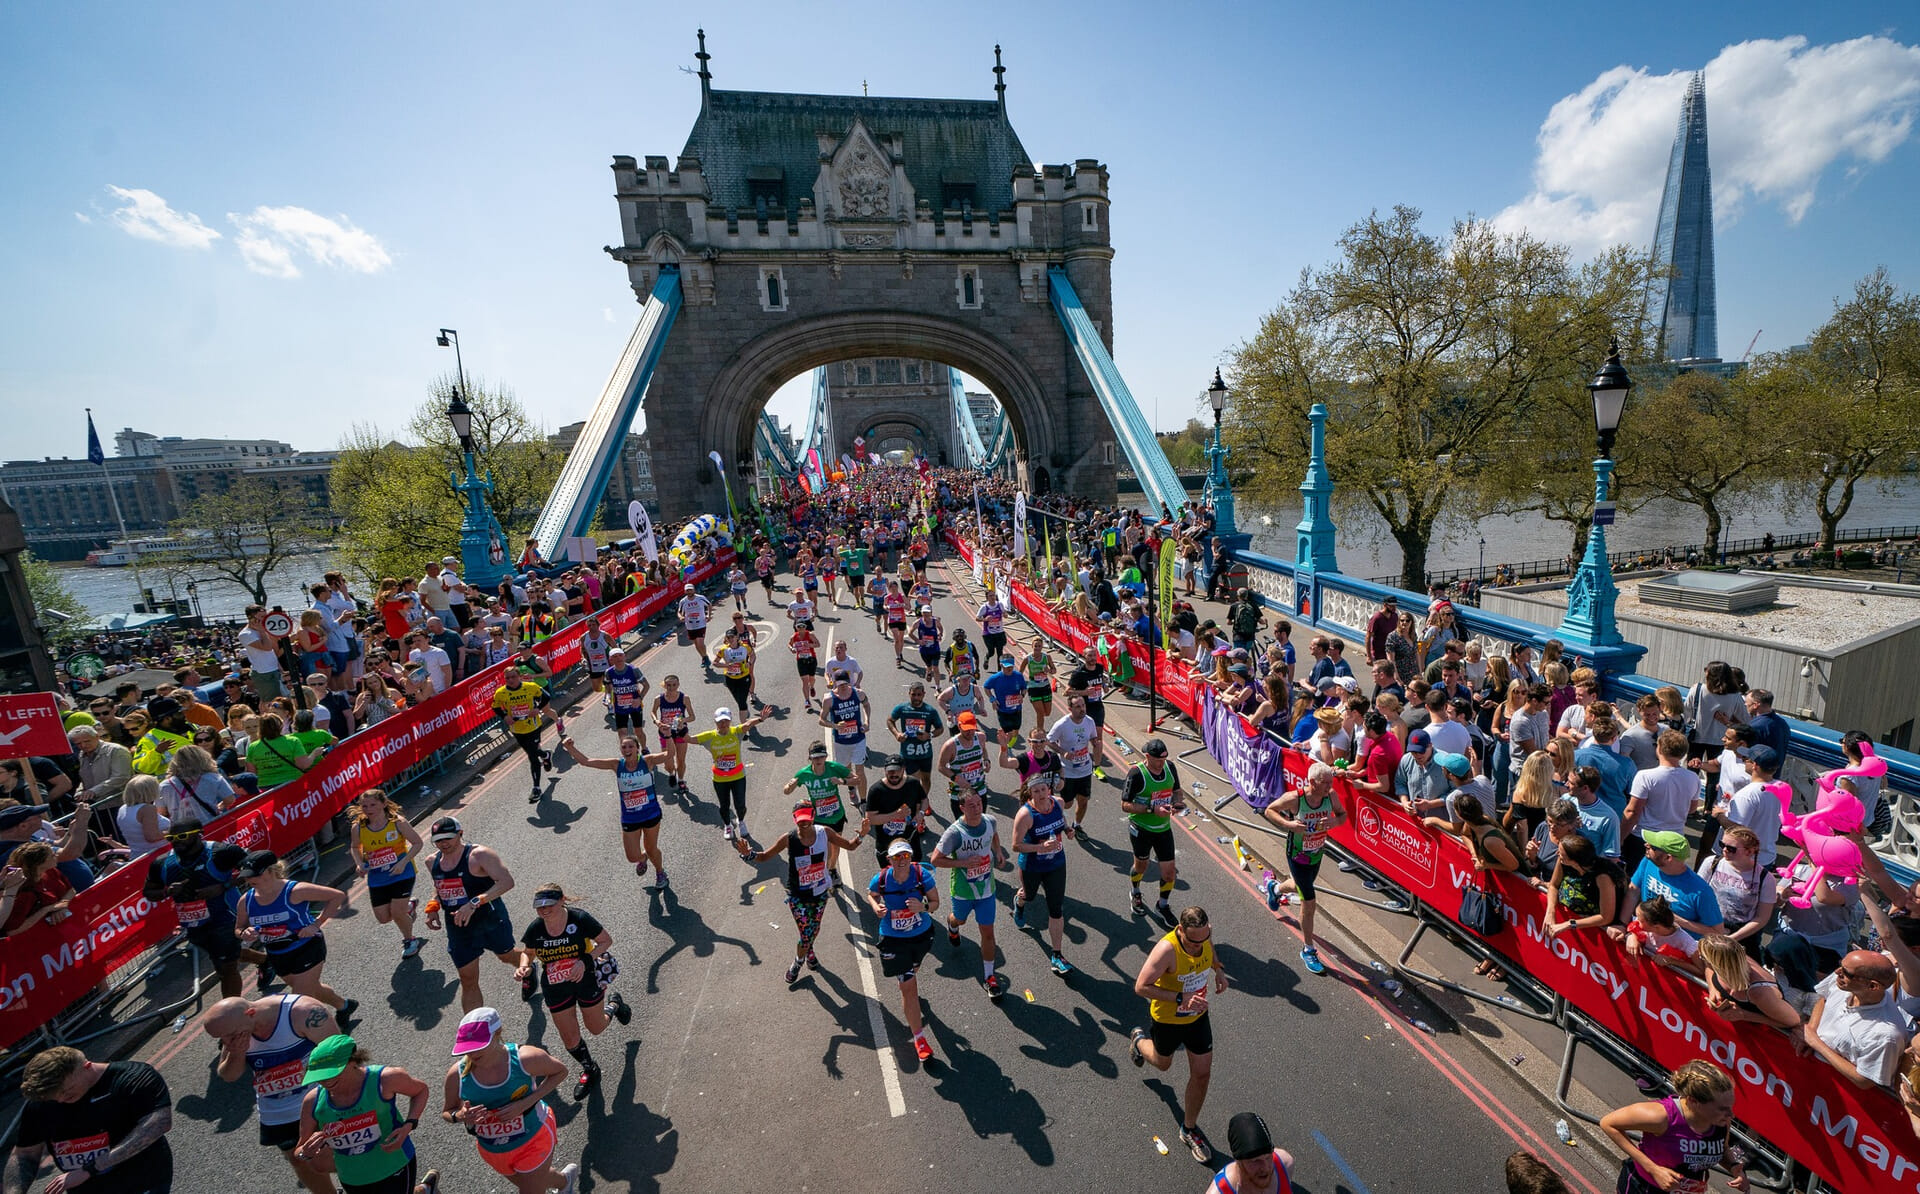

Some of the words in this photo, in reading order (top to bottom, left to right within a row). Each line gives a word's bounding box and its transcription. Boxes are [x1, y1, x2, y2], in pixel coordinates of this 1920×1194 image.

[266, 619, 288, 632] 20
[1060, 619, 1074, 636] Virgin
[1074, 628, 1091, 647] Money
[6, 707, 53, 720] LEFT!
[274, 790, 324, 826] Virgin
[321, 762, 362, 797] Money
[363, 733, 411, 768] London
[412, 704, 465, 740] Marathon
[620, 769, 645, 779] HELEN
[1362, 811, 1377, 829] Virgin
[1359, 831, 1378, 847] money
[1382, 821, 1420, 849] LONDON
[961, 838, 983, 851] JACK
[1381, 832, 1432, 868] MARATHON
[253, 915, 280, 925] ELLE
[543, 938, 569, 947] STEPH
[536, 944, 579, 957] Chorlton
[1526, 914, 1629, 1000] Money
[1638, 985, 1793, 1107] London
[273, 1063, 300, 1077] money
[346, 1116, 374, 1129] money
[477, 1118, 523, 1136] 41263
[75, 1138, 105, 1150] money
